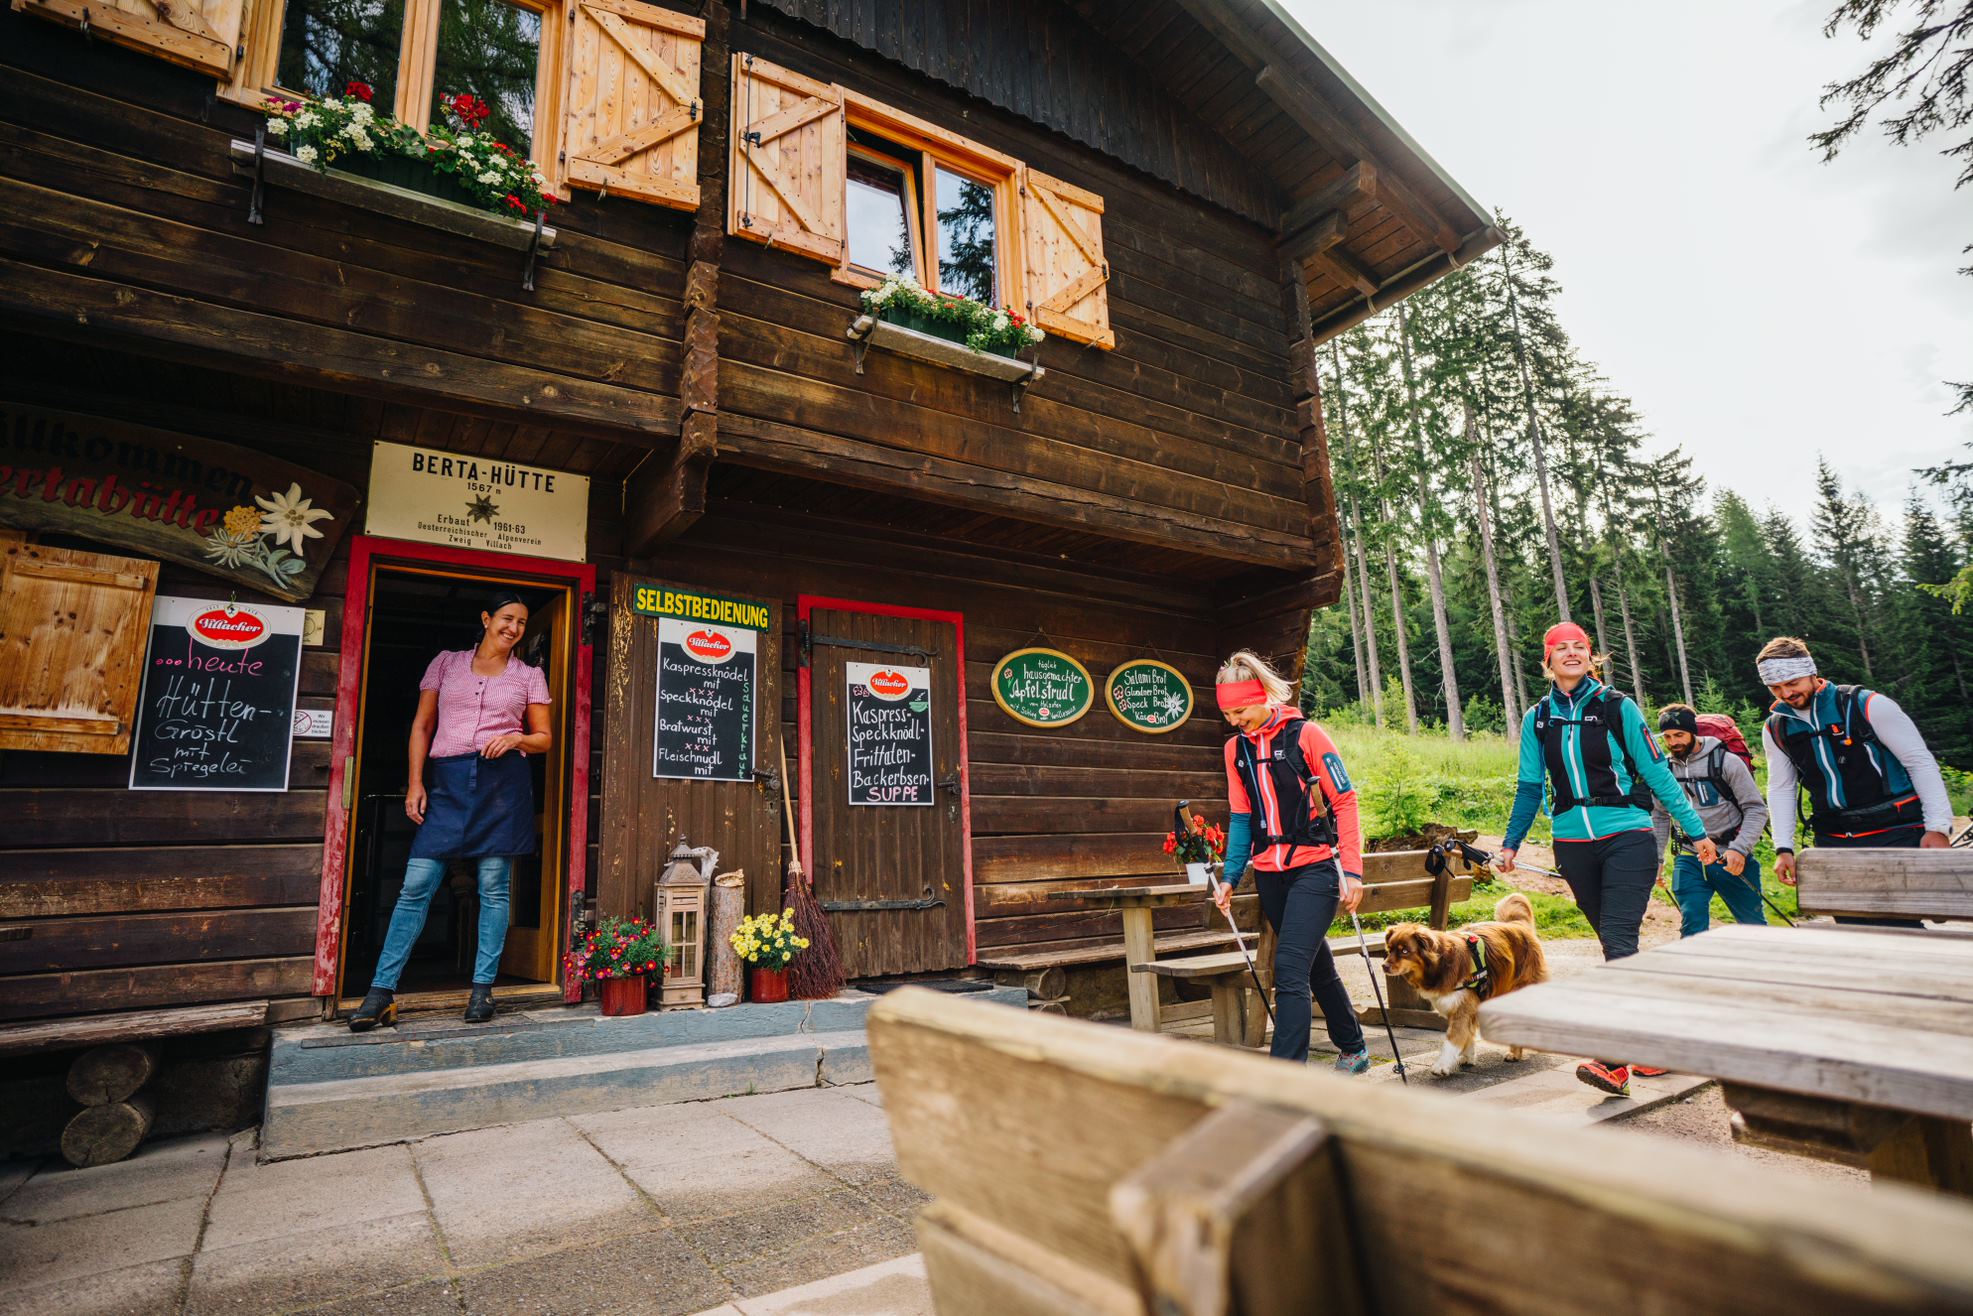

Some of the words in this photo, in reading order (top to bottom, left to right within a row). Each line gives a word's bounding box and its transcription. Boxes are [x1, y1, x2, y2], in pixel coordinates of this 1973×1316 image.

[412, 452, 556, 493] BERTA-HÜTTE
[467, 482, 493, 494] 1567
[437, 513, 470, 528] Erbaut
[493, 521, 526, 535] 1961-63
[417, 521, 488, 539] Oesterreichischer
[497, 533, 542, 547] Alpenverein
[448, 534, 472, 547] Zweig
[485, 539, 512, 551] Villach
[637, 587, 769, 629] SELBSTBEDIENUNG
[198, 617, 262, 633] Villacher
[663, 657, 749, 682] Kaspressknödel
[1023, 663, 1083, 684] hausgemachter
[1124, 669, 1151, 685] Salami
[1152, 668, 1167, 684] Brot
[703, 678, 720, 690] mit
[1009, 679, 1075, 703] Apfelstrudl
[1153, 685, 1168, 696] Brot
[659, 690, 734, 712] Speckknödel
[1126, 697, 1148, 714] Speck
[700, 706, 718, 718] mit
[852, 700, 912, 730] Kaspress-
[1154, 711, 1168, 725] Brot
[659, 718, 713, 736] Bratwurst
[738, 681, 750, 780] Sauerkraut
[697, 731, 718, 746] mit
[174, 742, 211, 761] mit
[658, 747, 723, 766] Fleischnudl
[149, 752, 253, 779] Spiegelei
[694, 763, 714, 776] mit
[865, 786, 919, 802] SUPPE
